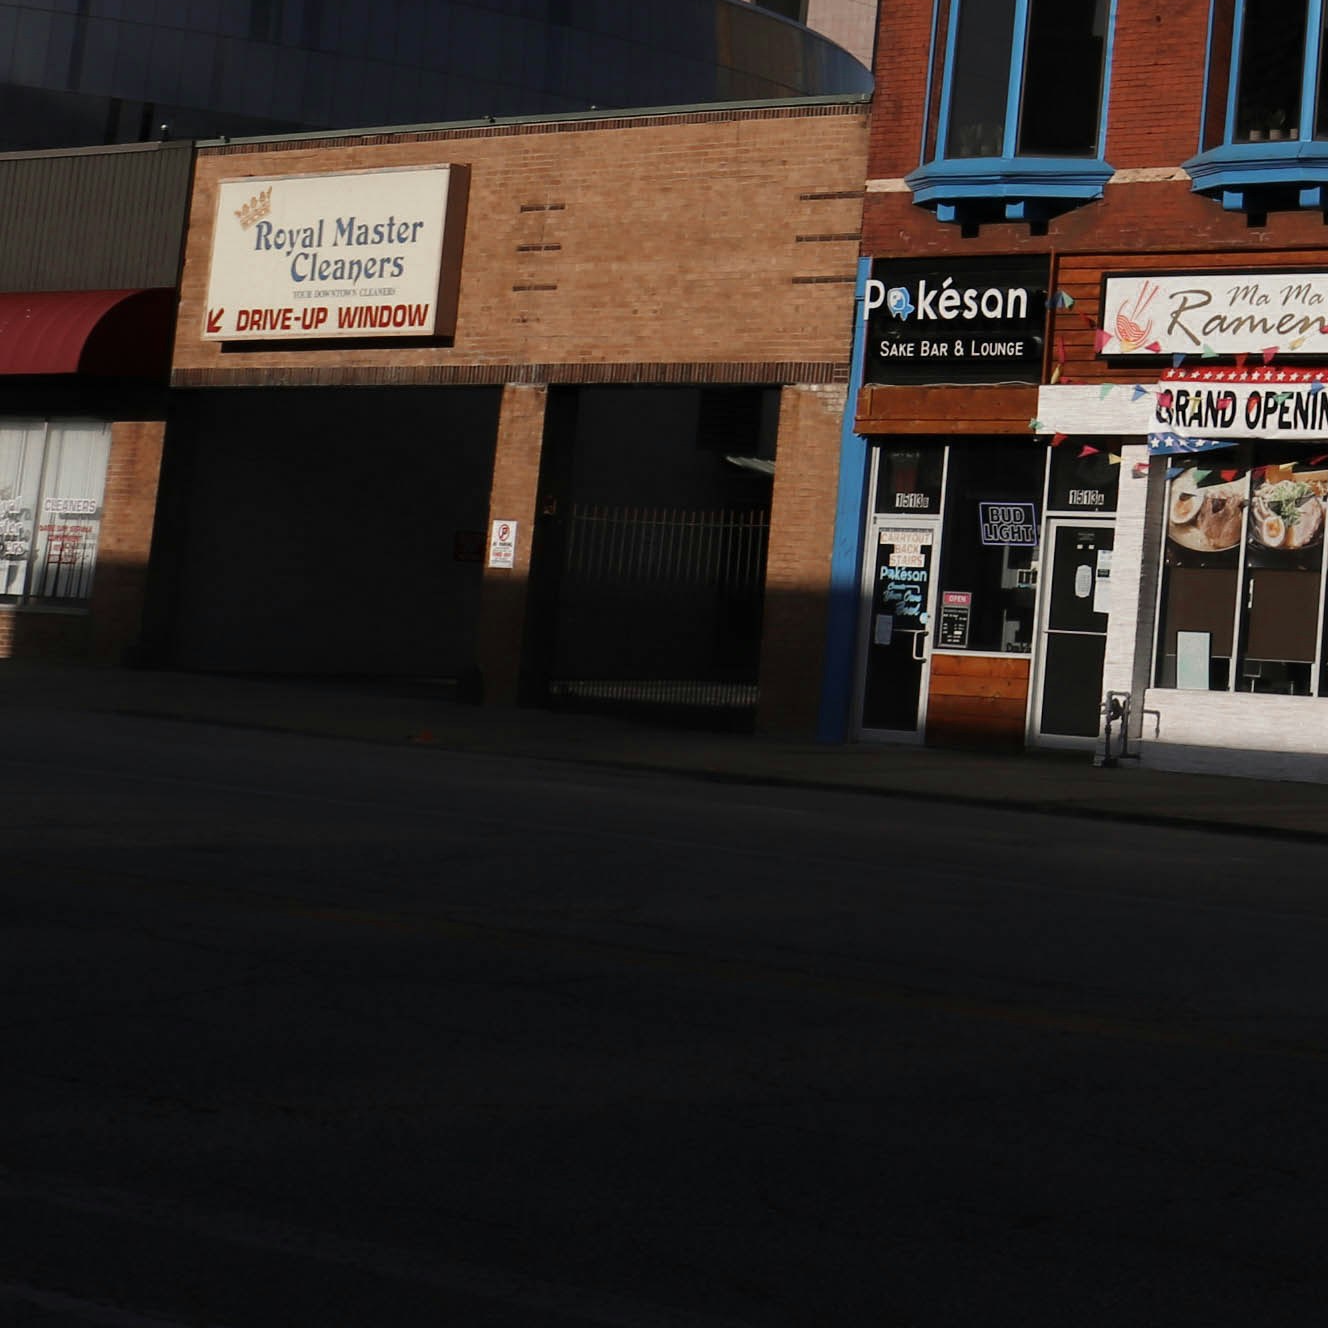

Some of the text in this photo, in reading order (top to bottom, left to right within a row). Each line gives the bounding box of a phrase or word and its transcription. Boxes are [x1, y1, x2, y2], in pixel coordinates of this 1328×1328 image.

[254, 216, 424, 257] Royal Master
[291, 252, 405, 286] Cleaners
[1227, 283, 1325, 308] Ma Ma
[236, 303, 430, 332] DRIVE-UP WINDOW
[1168, 289, 1328, 347] Ramen
[954, 339, 964, 356] &
[45, 499, 97, 513] CLEANERS
[989, 506, 1025, 524] BUD
[984, 523, 1033, 542] LIGHT
[894, 544, 920, 554] BACK
[890, 555, 923, 566] STAIRS
